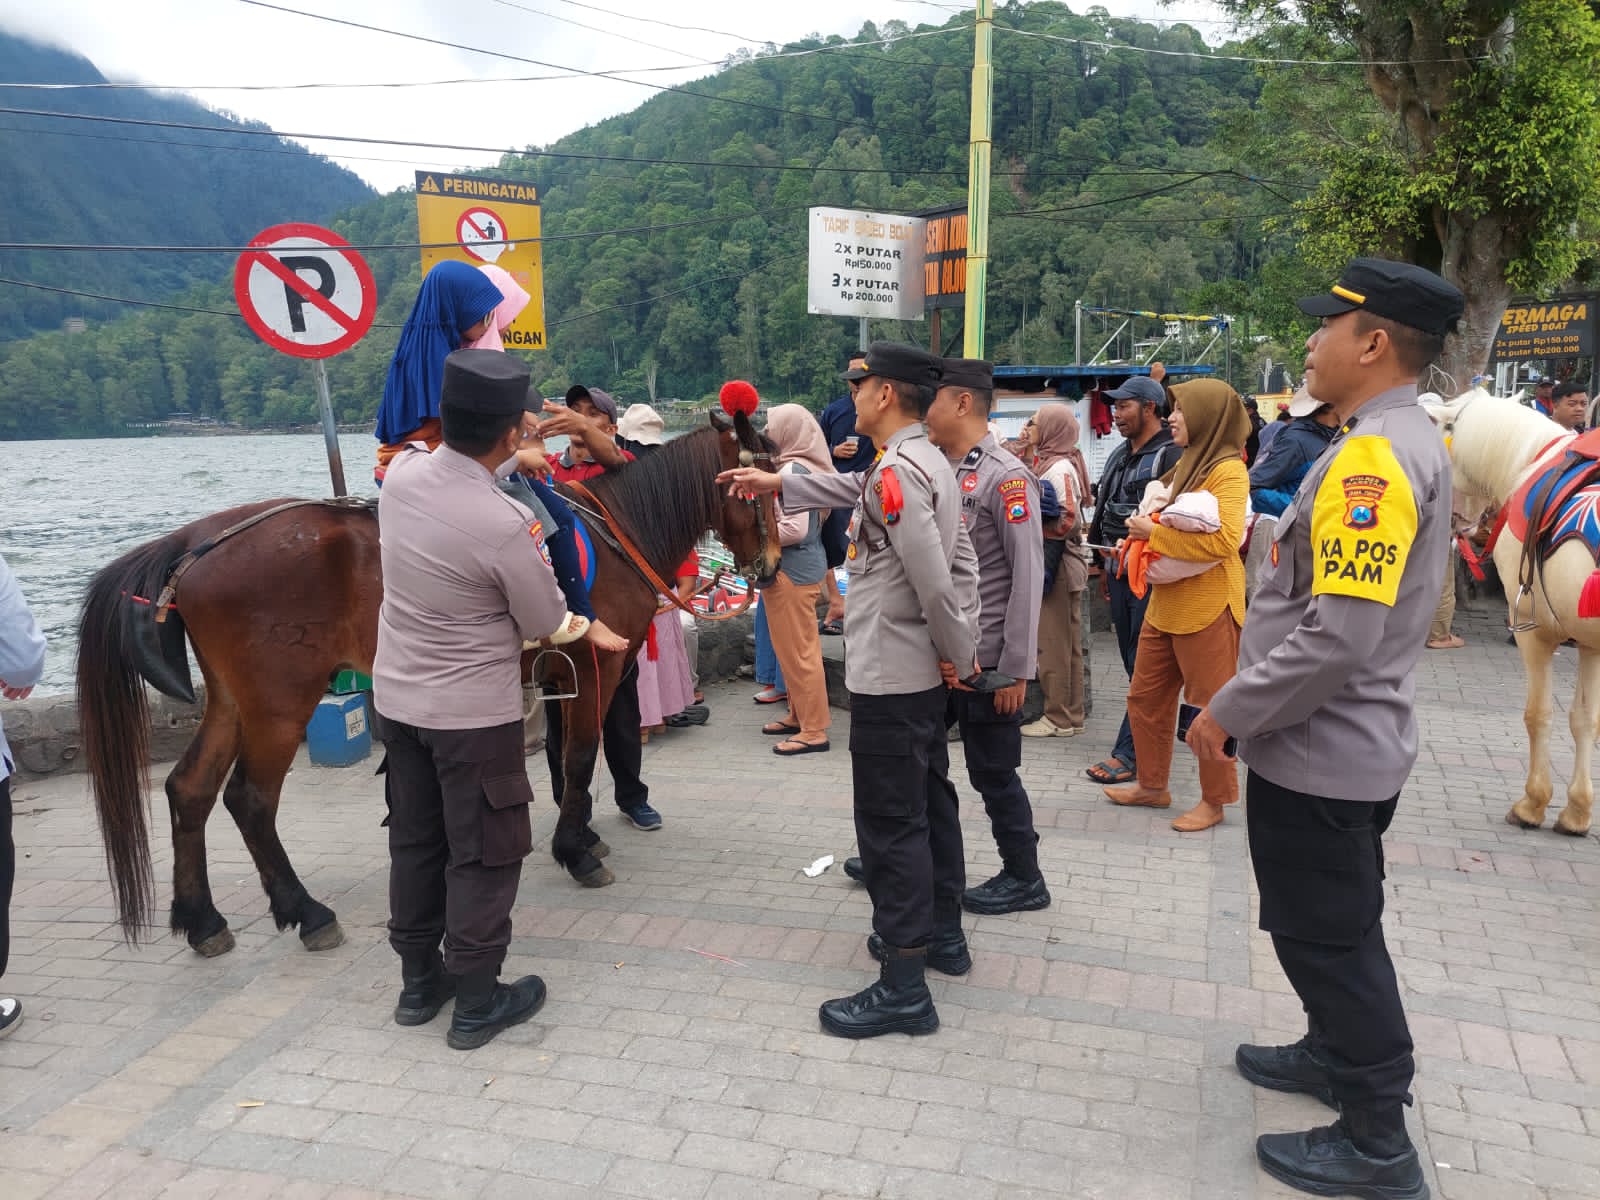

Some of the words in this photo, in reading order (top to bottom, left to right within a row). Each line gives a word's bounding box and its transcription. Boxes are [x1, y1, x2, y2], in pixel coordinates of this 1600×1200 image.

[443, 178, 537, 200] PERINGATAN
[857, 246, 901, 260] PUTAR
[856, 278, 899, 291] PUTAR
[1502, 304, 1586, 326] ERMAGA
[1506, 323, 1539, 335] SPEED
[1541, 321, 1569, 332] BOAT
[502, 329, 542, 345] NGAN
[1508, 338, 1531, 348] putar
[1508, 348, 1531, 357] putar
[1320, 537, 1343, 559] KA
[1355, 539, 1398, 565] POS
[1323, 560, 1383, 585] PAM
